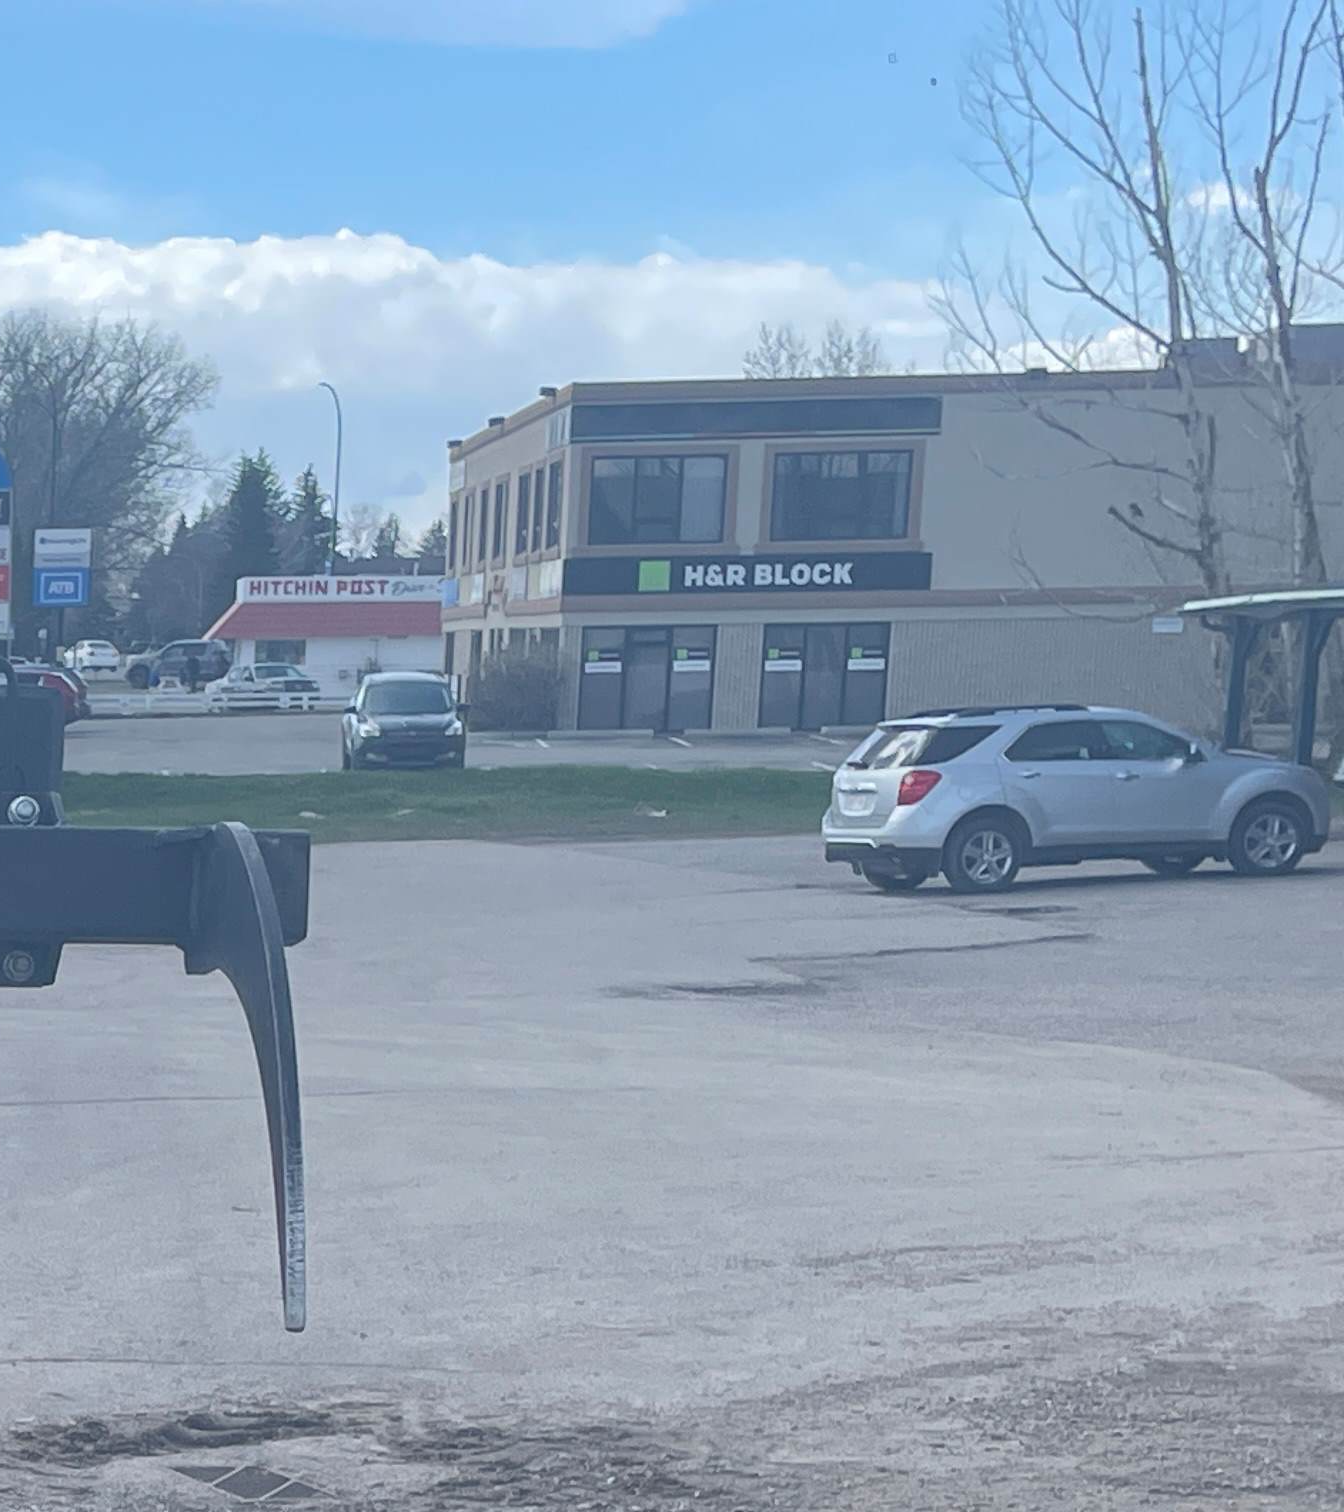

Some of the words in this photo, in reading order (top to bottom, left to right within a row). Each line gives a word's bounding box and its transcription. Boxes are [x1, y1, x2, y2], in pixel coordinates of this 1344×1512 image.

[684, 564, 746, 587] H&R
[754, 563, 853, 586] BLOCK
[249, 580, 328, 595] HITCHIN
[336, 580, 390, 595] POST
